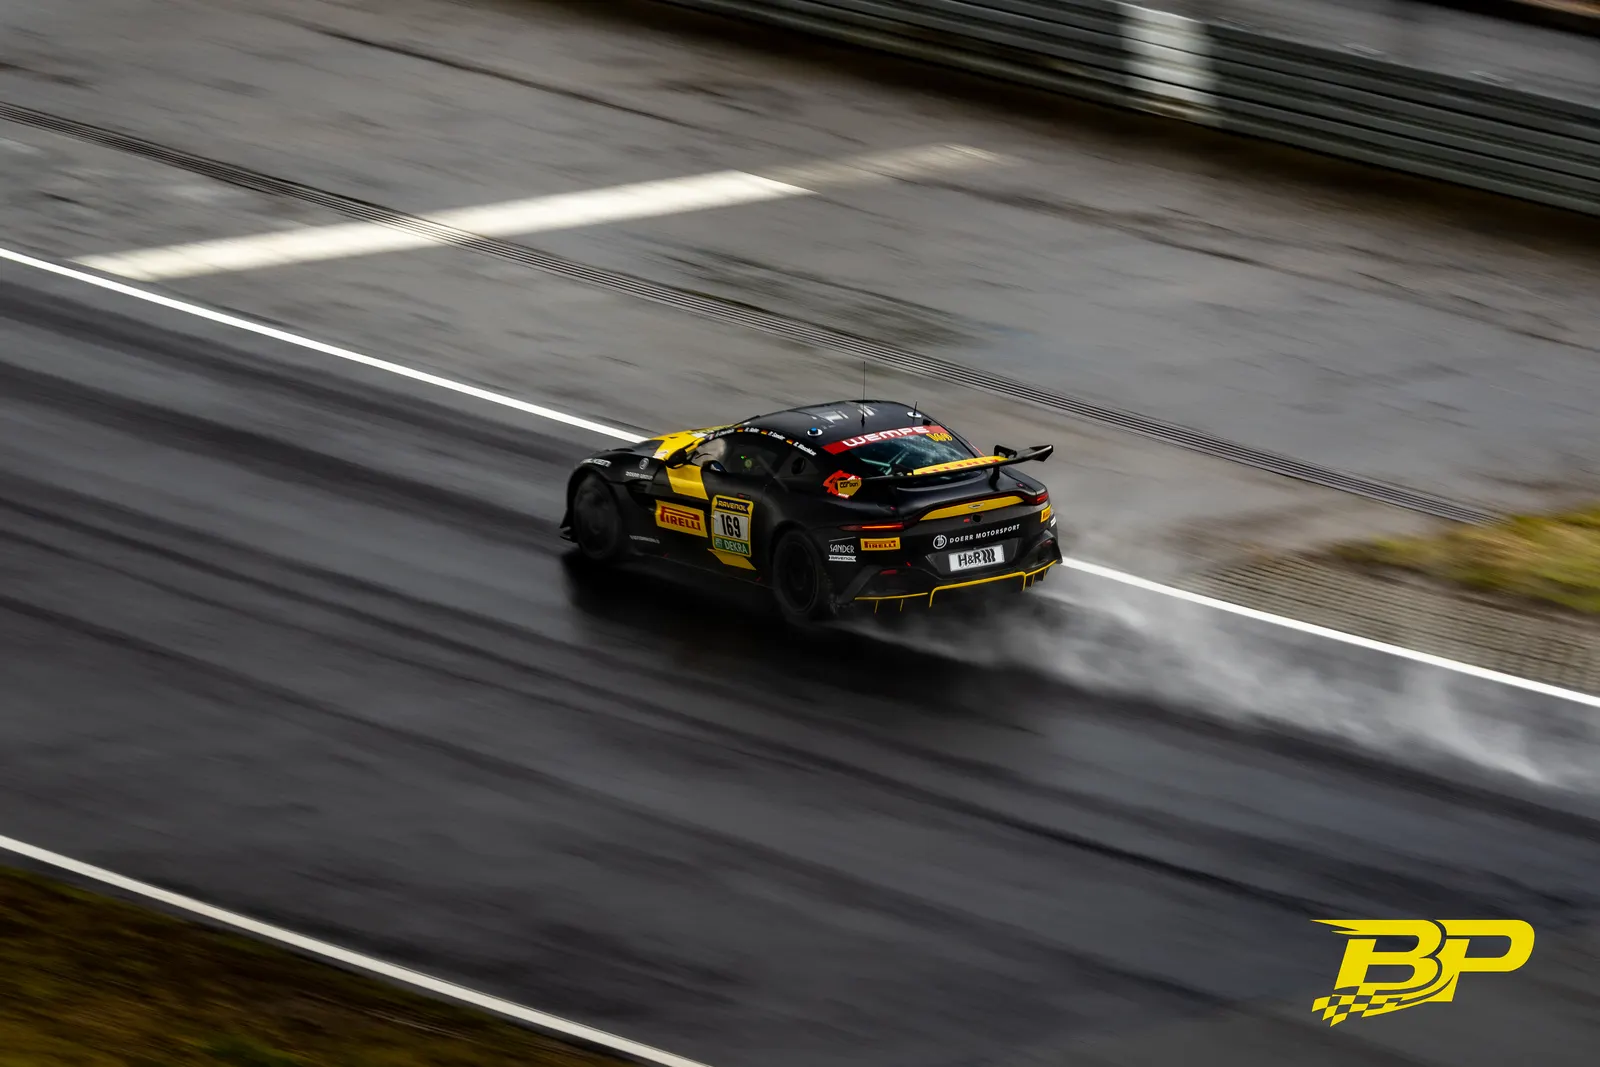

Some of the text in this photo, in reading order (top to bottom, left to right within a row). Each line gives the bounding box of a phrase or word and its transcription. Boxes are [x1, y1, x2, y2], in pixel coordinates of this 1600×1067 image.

[842, 426, 930, 447] WEMPE
[718, 500, 747, 512] RAVENOL
[660, 506, 701, 531] PIRELLI
[720, 513, 741, 538] 169
[949, 524, 1020, 543] DOERR MOTORSPORT
[724, 539, 748, 554] DEKRA
[830, 544, 855, 553] SANDER
[864, 540, 897, 548] PIRELLI
